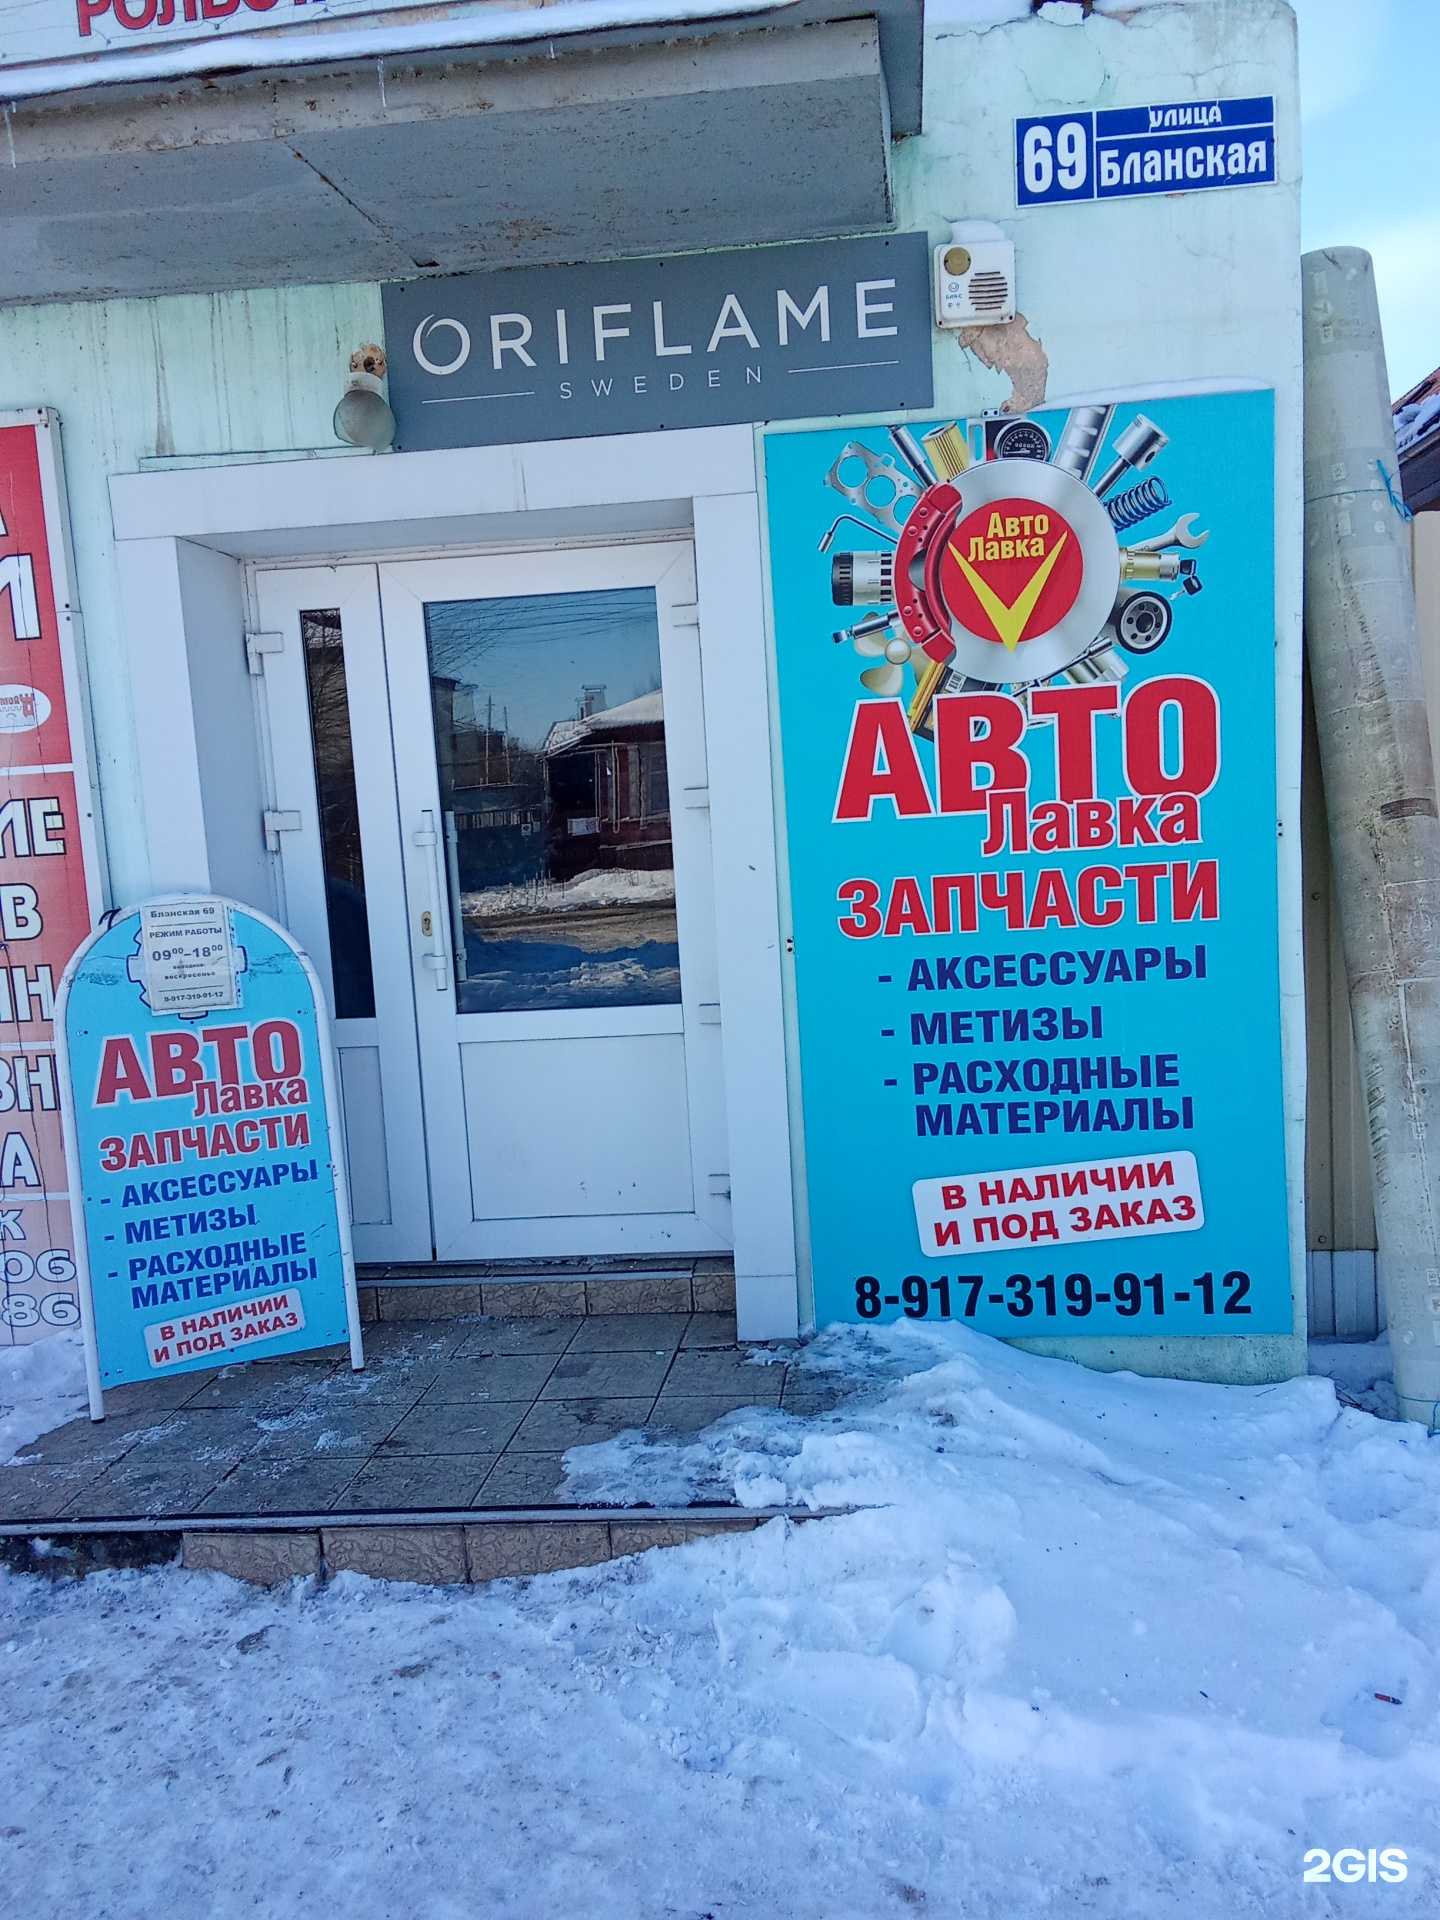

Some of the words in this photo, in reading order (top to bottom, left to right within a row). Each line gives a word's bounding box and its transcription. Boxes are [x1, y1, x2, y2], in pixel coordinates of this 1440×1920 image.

[1149, 105, 1222, 129] улица
[1024, 122, 1087, 193] 69
[1100, 142, 1267, 186] Бланская
[413, 279, 898, 374] ORIFLAME
[560, 366, 761, 398] SWEDEN
[968, 536, 1045, 562] Лавка
[987, 513, 1049, 538] Авто
[836, 678, 1219, 820] АВТО
[983, 791, 1202, 855] Лавка
[202, 907, 215, 915] 69
[839, 861, 1218, 938] ЗАПЧАСТИ
[149, 929, 183, 938] РЕЖИМ
[184, 927, 222, 936] РАБОТЫ
[907, 944, 1207, 992] АКСЕССУАРЫ
[910, 1005, 1103, 1046] МЕТИЗЫ
[96, 1020, 302, 1105] АВТО
[913, 1053, 1180, 1096] РАСХОДНЫЕ
[194, 1077, 308, 1118] Лавка
[915, 1097, 1194, 1137] МАТЕРИАЛЫ
[100, 1113, 310, 1171] ЗАПЧАСТИ
[121, 1159, 319, 1208] АКСЕССУАРЫ
[941, 1185, 967, 1210] В
[979, 1160, 1176, 1206] НАЛИЧИИ
[124, 1203, 257, 1245] МЕТИЗЫ
[934, 1221, 960, 1247] И
[973, 1209, 1060, 1243] ПОД
[1069, 1194, 1197, 1232] ЗАКАЗ
[128, 1231, 308, 1281] РАСХОДНЫЕ
[131, 1256, 319, 1309] МАТЕРИАЛЫ
[854, 1270, 1253, 1320] 8-917-319-91-12
[154, 1345, 169, 1363] И
[176, 1334, 226, 1357] ПОД
[230, 1311, 298, 1342] ЗАКАЗ
[160, 1325, 176, 1341] В
[181, 1294, 289, 1337] НАЛИЧИИ
